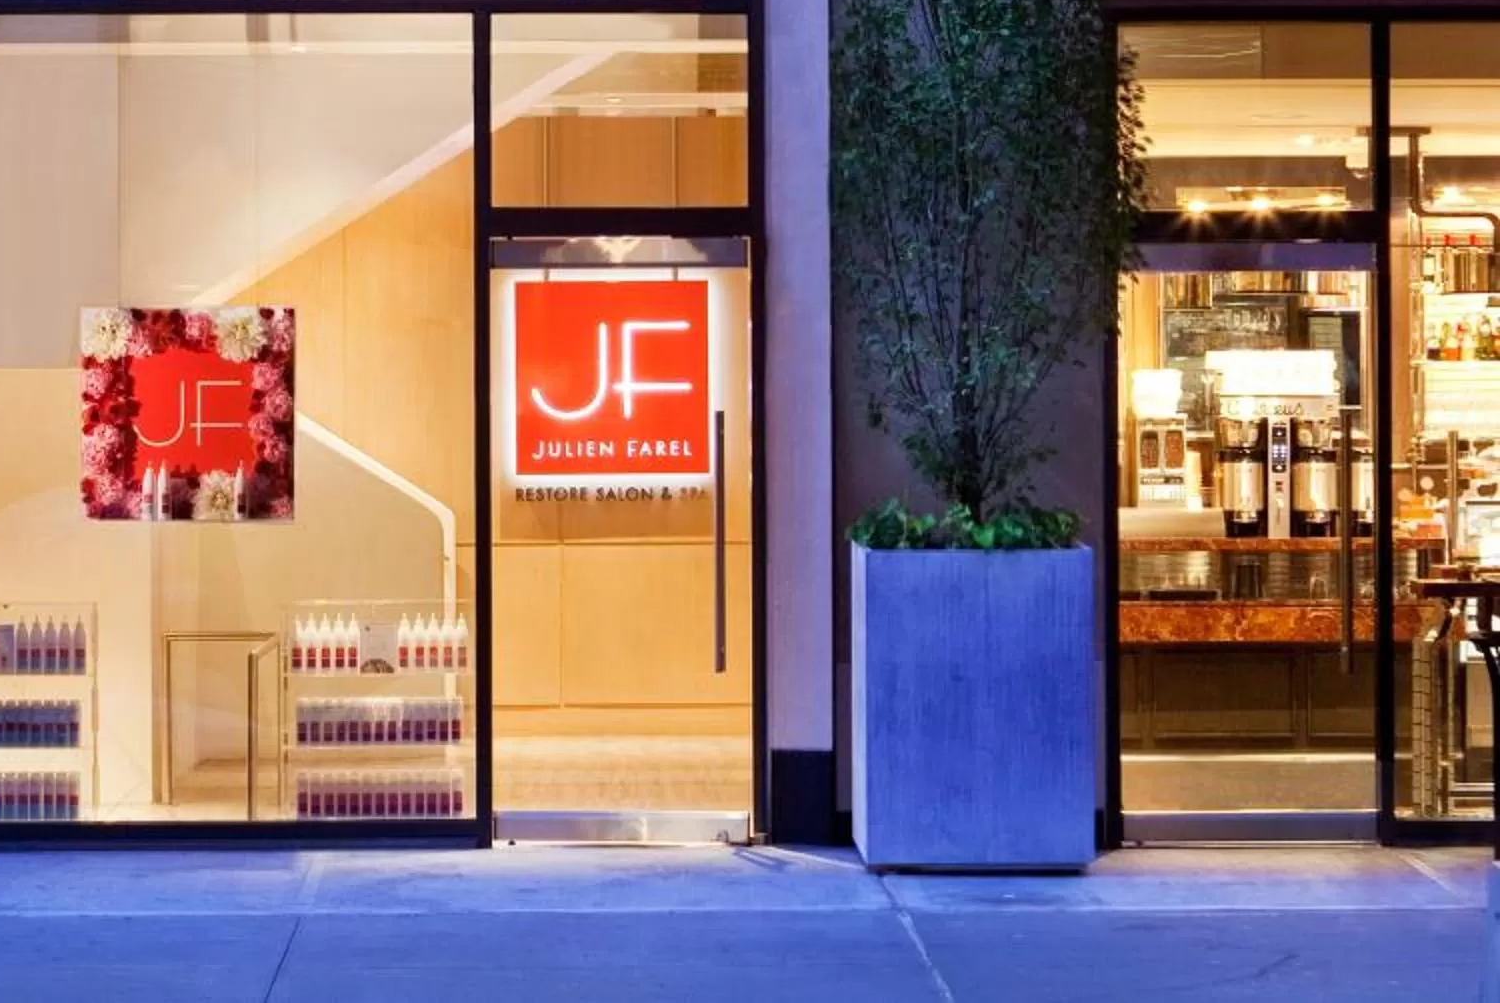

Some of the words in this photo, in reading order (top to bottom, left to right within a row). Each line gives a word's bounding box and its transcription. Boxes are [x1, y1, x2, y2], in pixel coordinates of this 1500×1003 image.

[531, 320, 693, 420] JF
[133, 380, 244, 447] JF
[532, 439, 616, 460] JULIEN
[626, 439, 693, 459] FAREL
[515, 486, 589, 502] RESTORE
[596, 486, 654, 502] SALON
